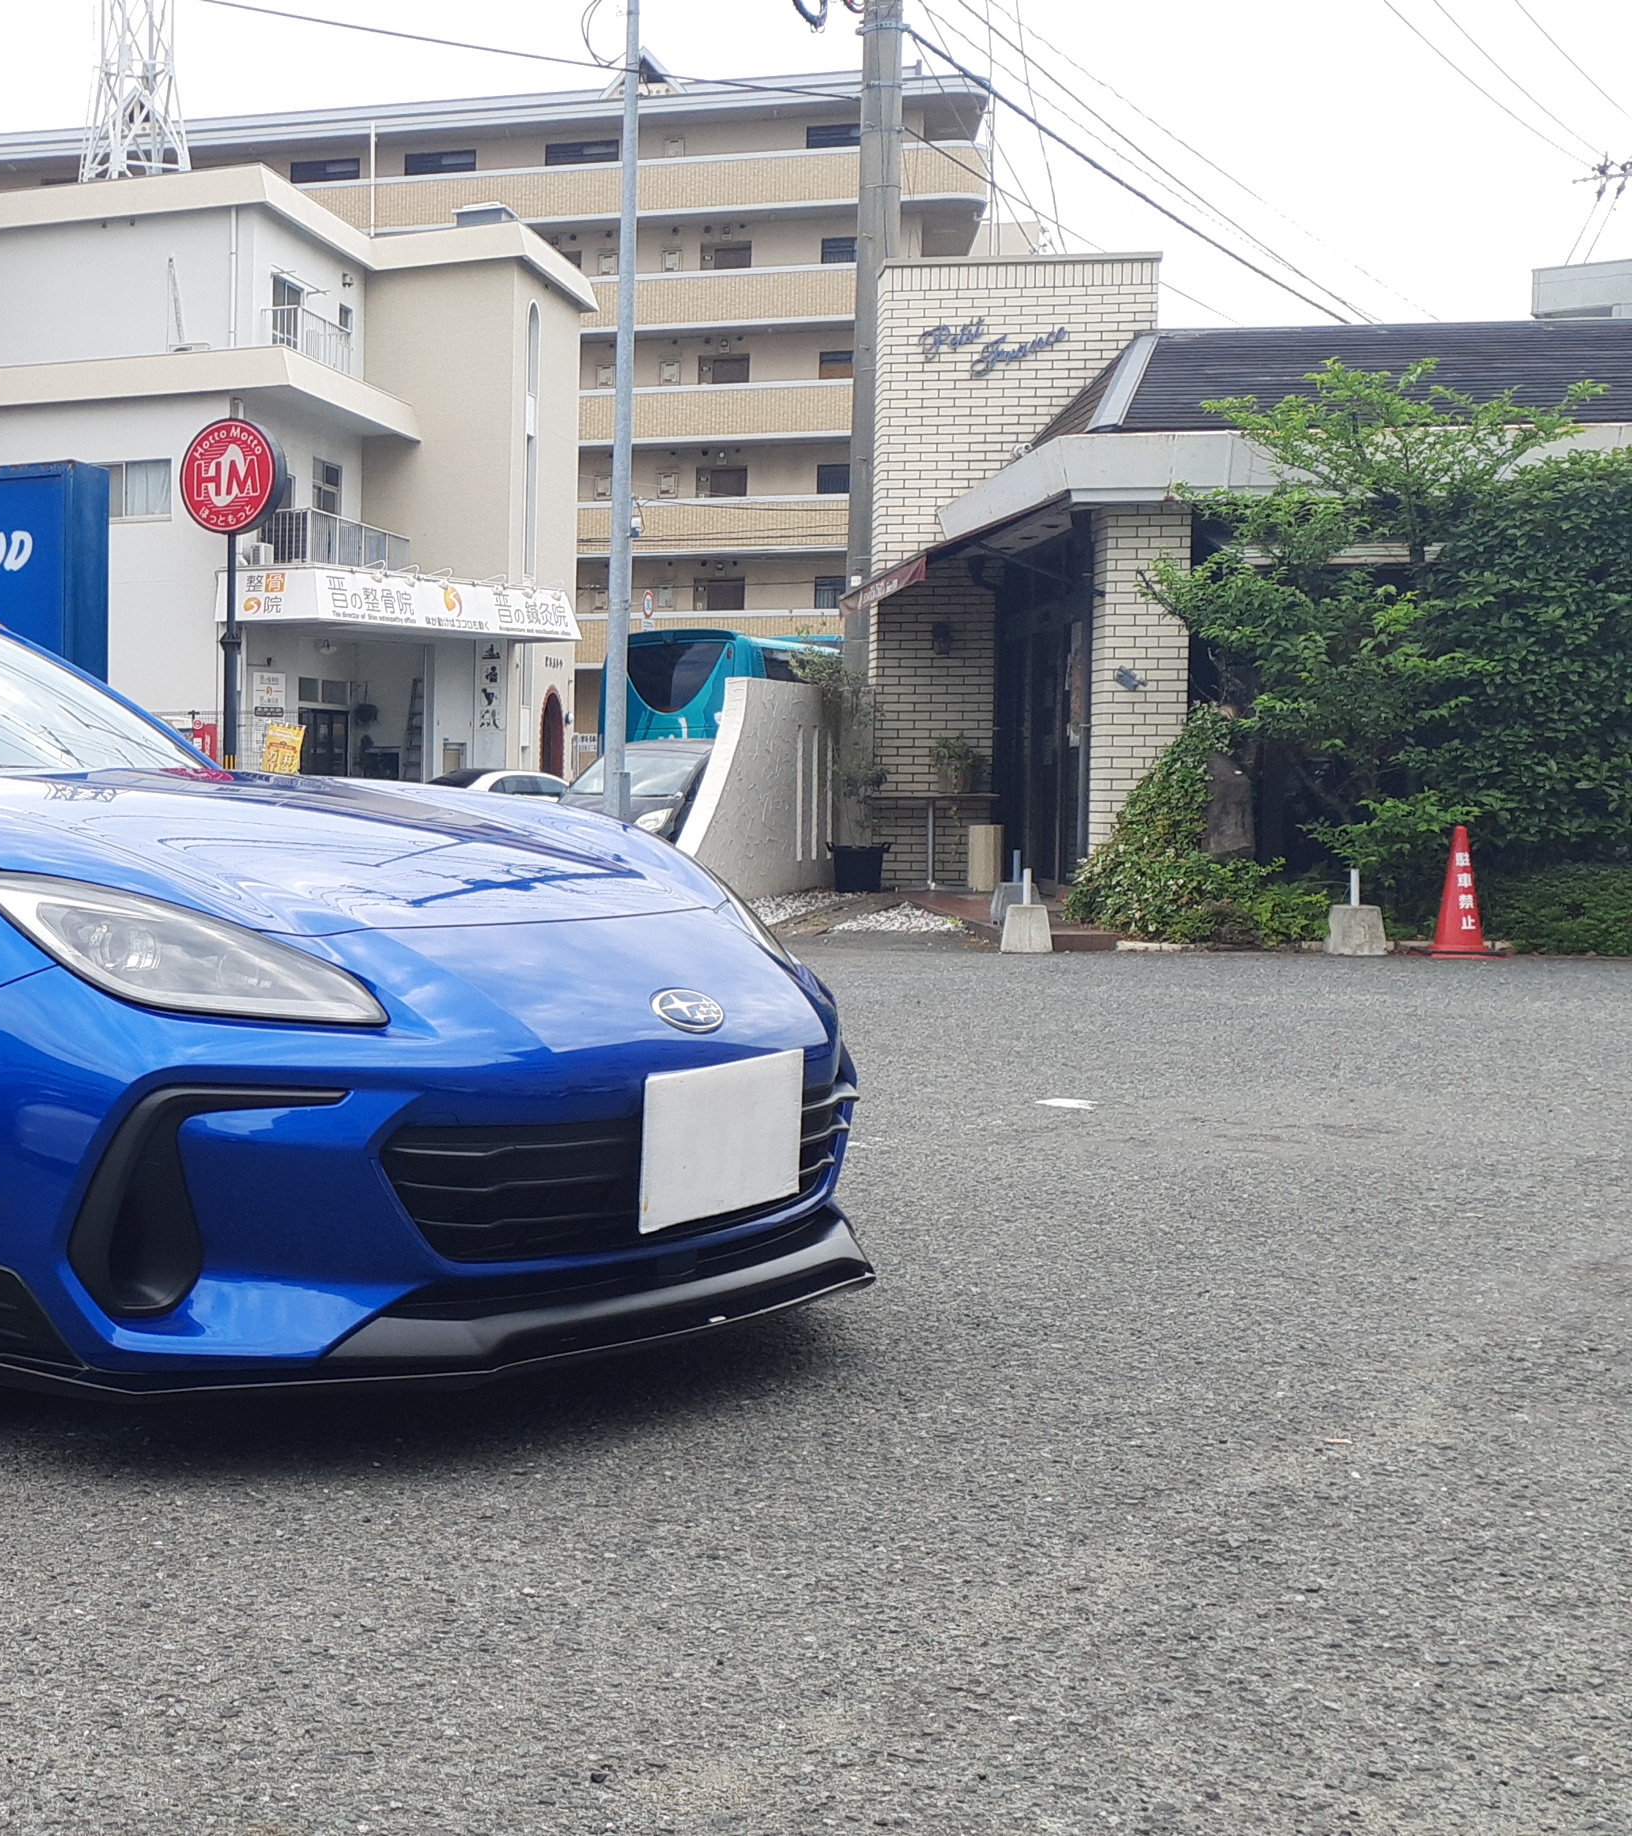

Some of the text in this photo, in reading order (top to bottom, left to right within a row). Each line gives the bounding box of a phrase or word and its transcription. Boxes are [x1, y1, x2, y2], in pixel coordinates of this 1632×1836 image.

[193, 425, 263, 459] Hotto Motto
[194, 455, 261, 501] HM
[199, 504, 255, 526] ほっともっと
[263, 595, 283, 614] 院
[1455, 851, 1477, 930] 駐車禁止
